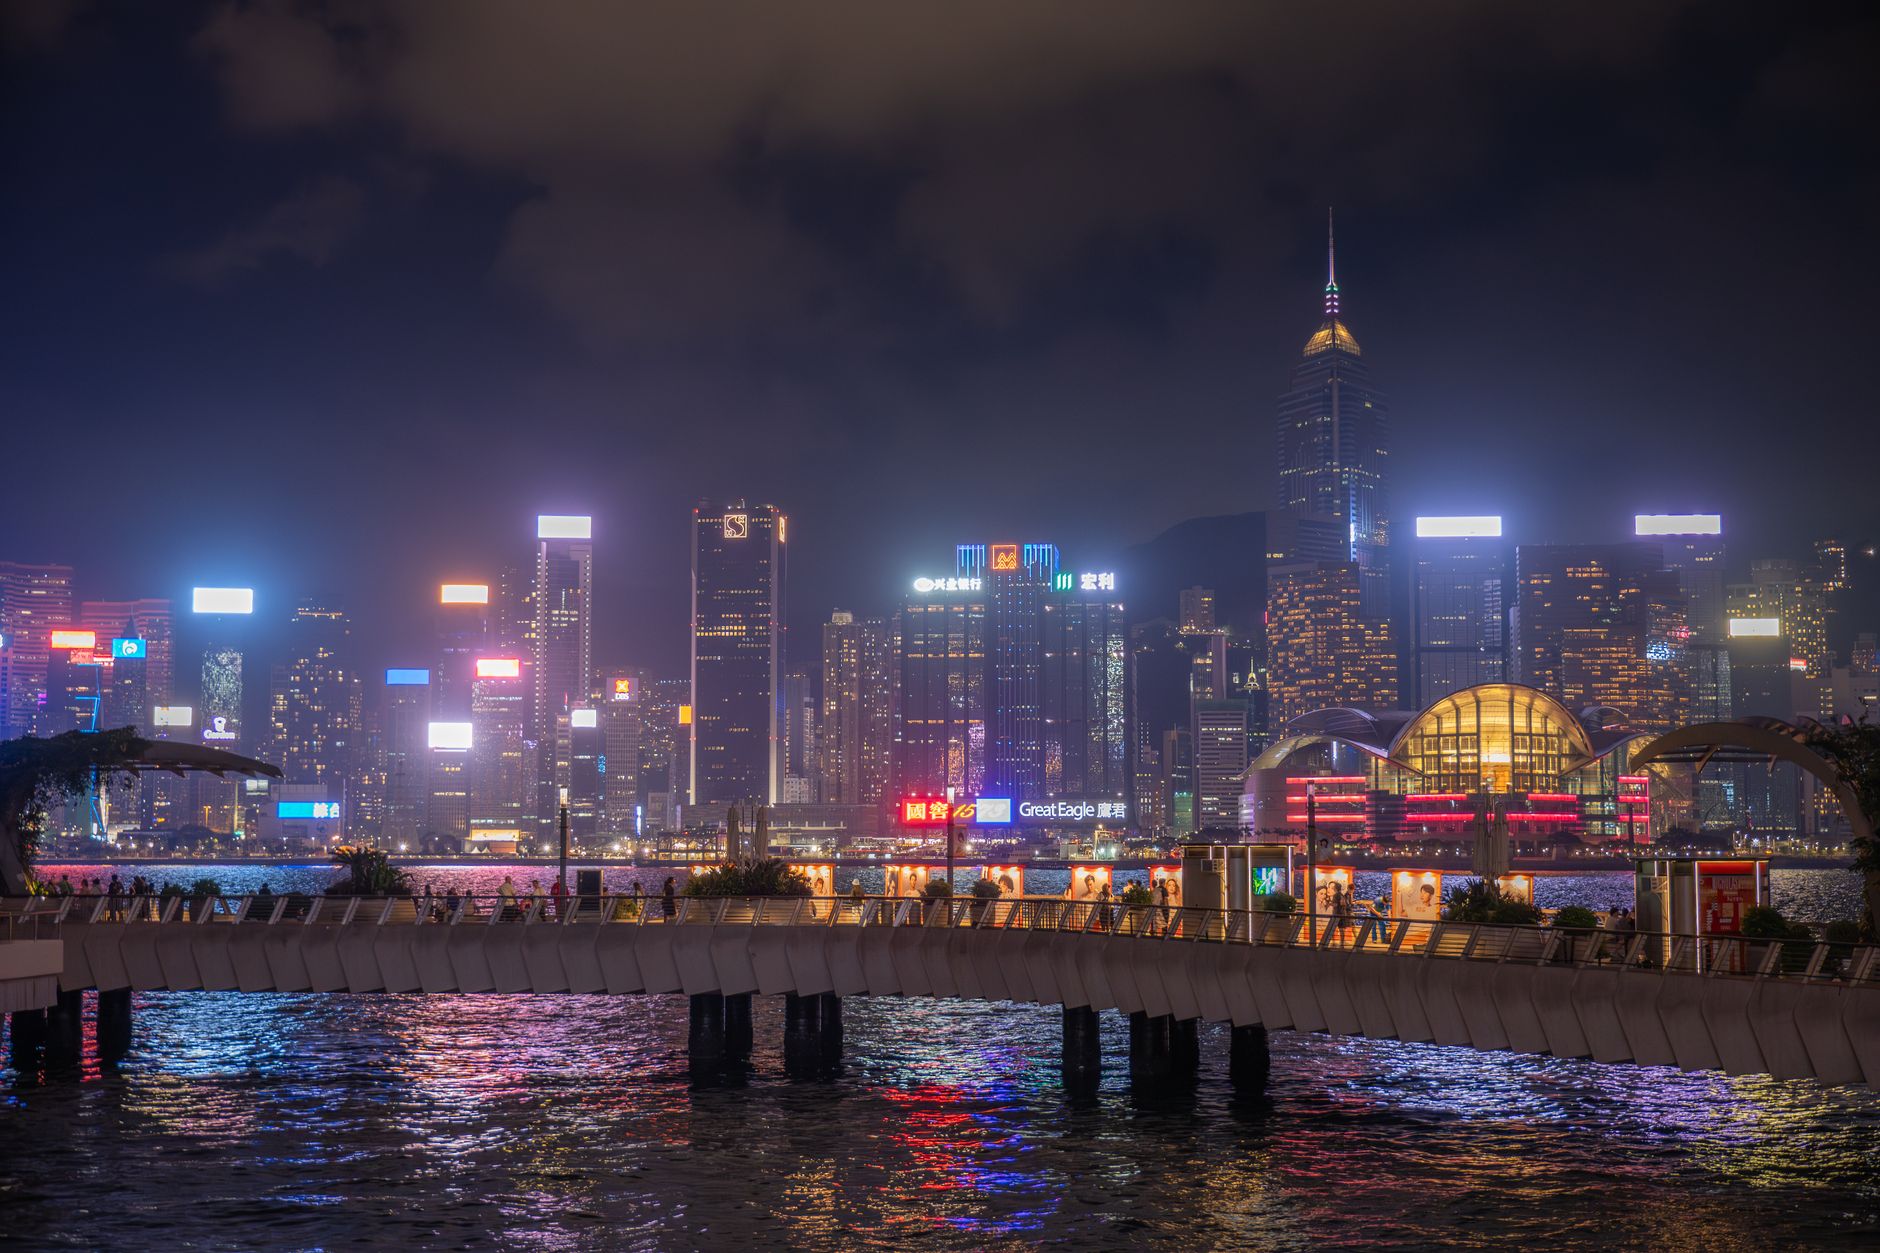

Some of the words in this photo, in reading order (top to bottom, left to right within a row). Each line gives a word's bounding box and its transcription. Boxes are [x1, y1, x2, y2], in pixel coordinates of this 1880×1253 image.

[1081, 573, 1114, 590] 宏利
[615, 692, 629, 700] DBS
[906, 801, 948, 820] 國窖
[1019, 802, 1057, 817] Great
[1058, 801, 1095, 820] Eagle
